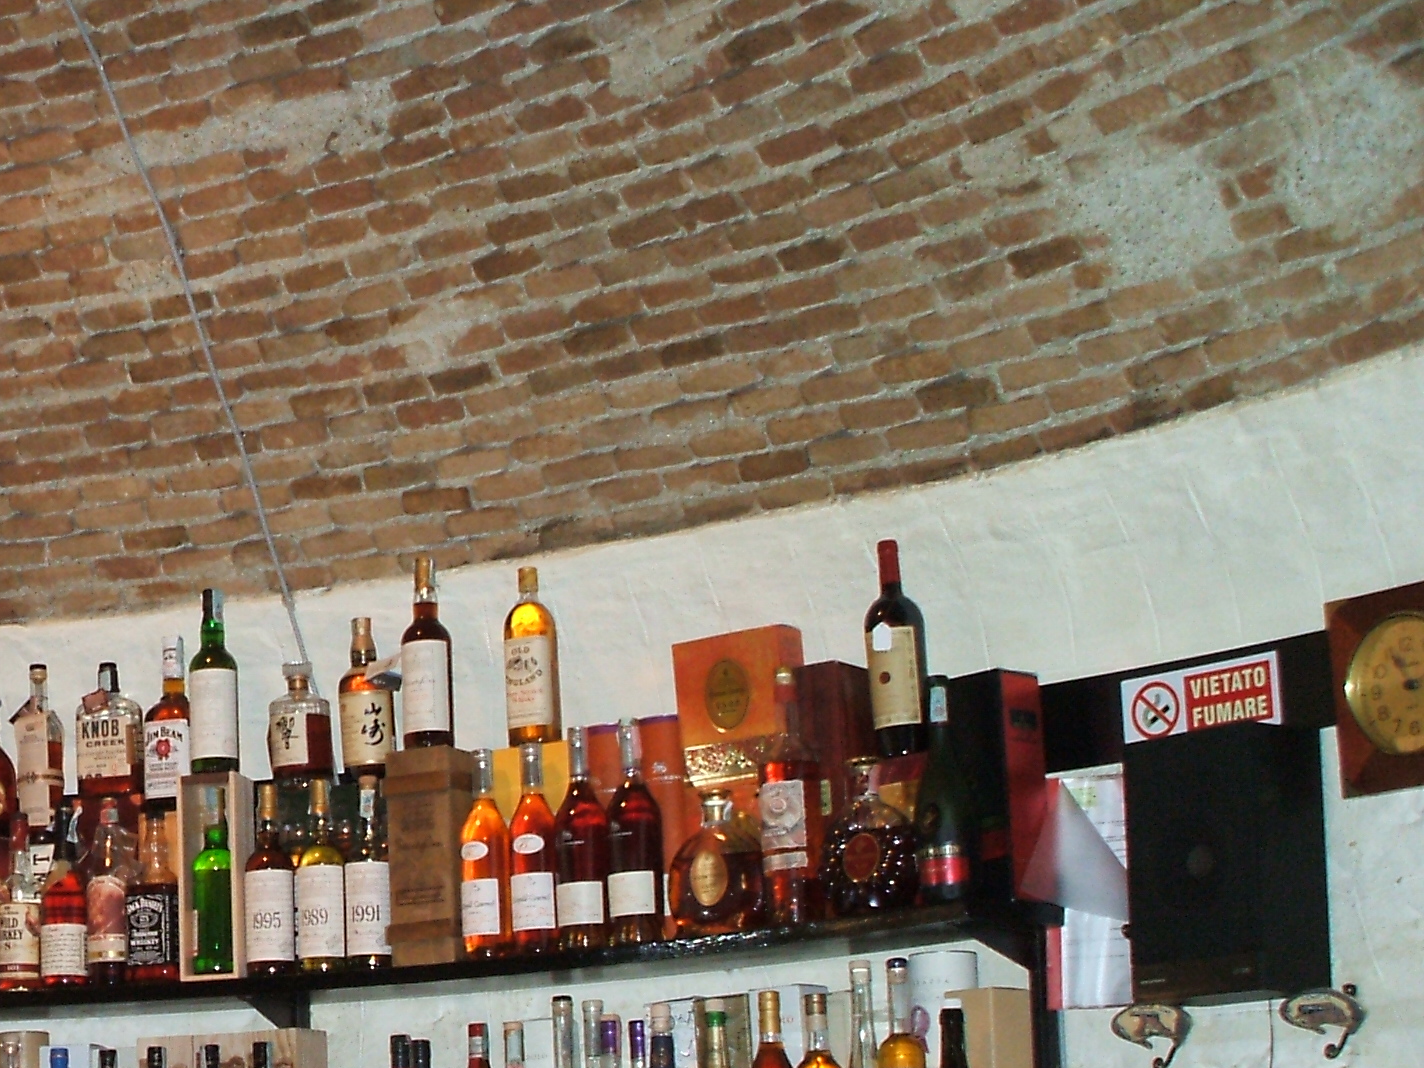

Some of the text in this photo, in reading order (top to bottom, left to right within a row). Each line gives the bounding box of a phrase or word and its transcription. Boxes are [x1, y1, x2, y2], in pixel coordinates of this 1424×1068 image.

[1189, 666, 1266, 699] VIETATO
[1191, 695, 1269, 728] FUMARE
[81, 717, 121, 740] KNOB
[85, 739, 125, 748] CREEK
[252, 911, 282, 930] 1995
[300, 909, 329, 927] 1989
